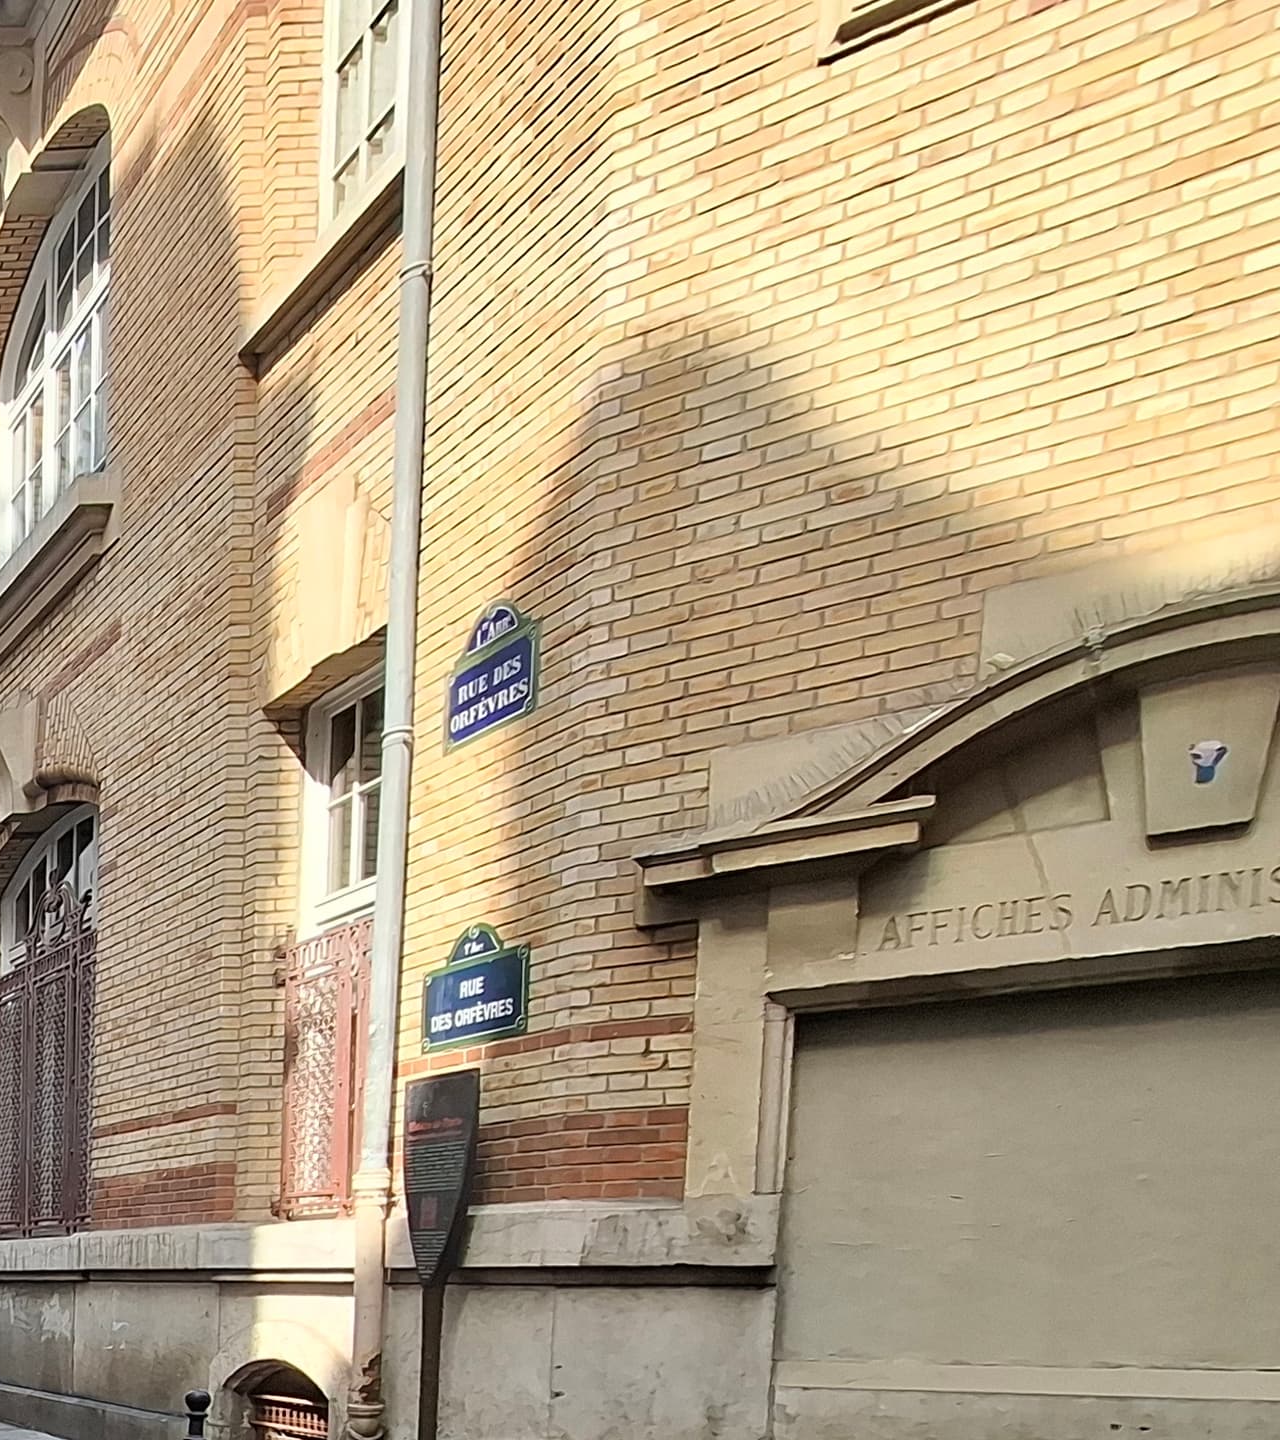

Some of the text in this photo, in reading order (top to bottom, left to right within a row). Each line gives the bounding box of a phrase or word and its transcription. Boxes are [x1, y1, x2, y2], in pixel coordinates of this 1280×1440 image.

[450, 677, 529, 734] ORFÈVRES
[458, 654, 522, 706] RUE DES
[876, 893, 1074, 951] AFFICHES
[458, 975, 485, 1000] RUE
[430, 997, 515, 1034] DES ORFÈVRES
